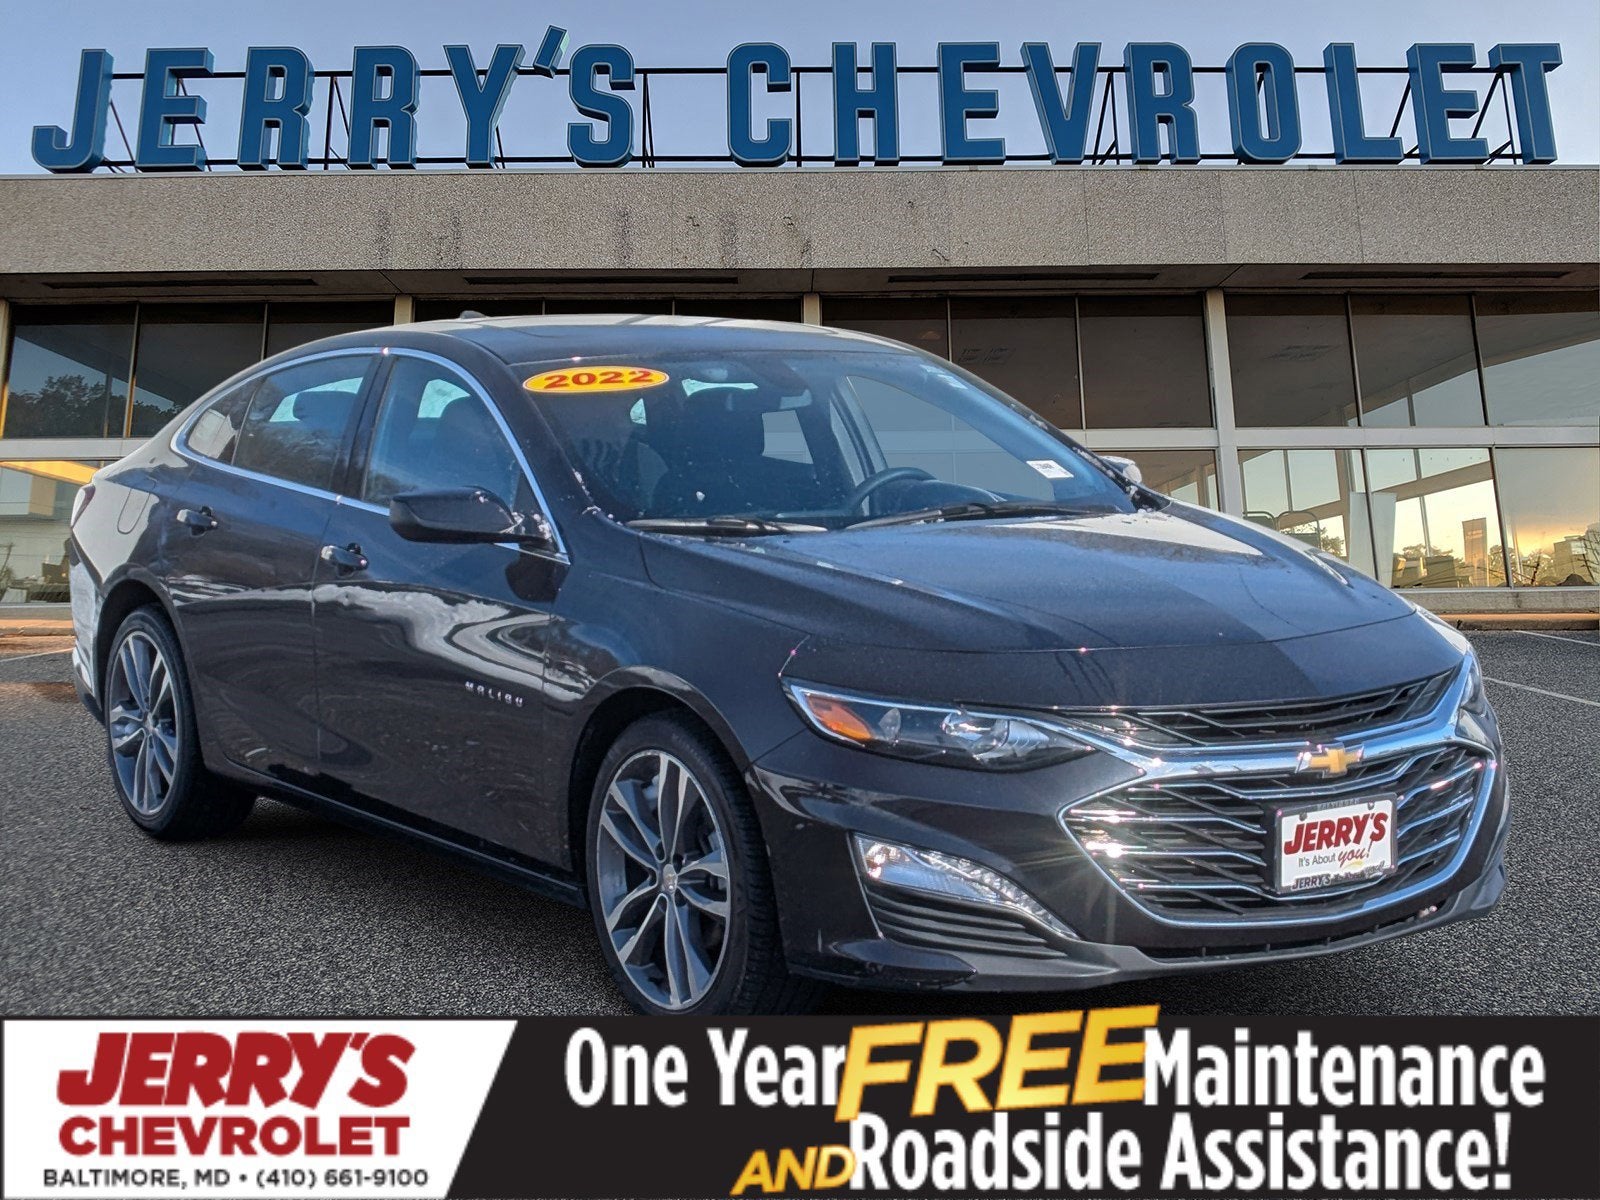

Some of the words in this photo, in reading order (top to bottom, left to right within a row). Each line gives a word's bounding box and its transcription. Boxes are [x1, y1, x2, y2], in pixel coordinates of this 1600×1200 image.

[31, 25, 635, 173] JERRY'S
[727, 41, 1562, 168] CHEVROLET
[543, 370, 654, 389] 2022
[1284, 812, 1388, 855] JERRY'S
[1298, 856, 1310, 868] It's
[1312, 853, 1336, 865] About
[1337, 839, 1373, 868] you!
